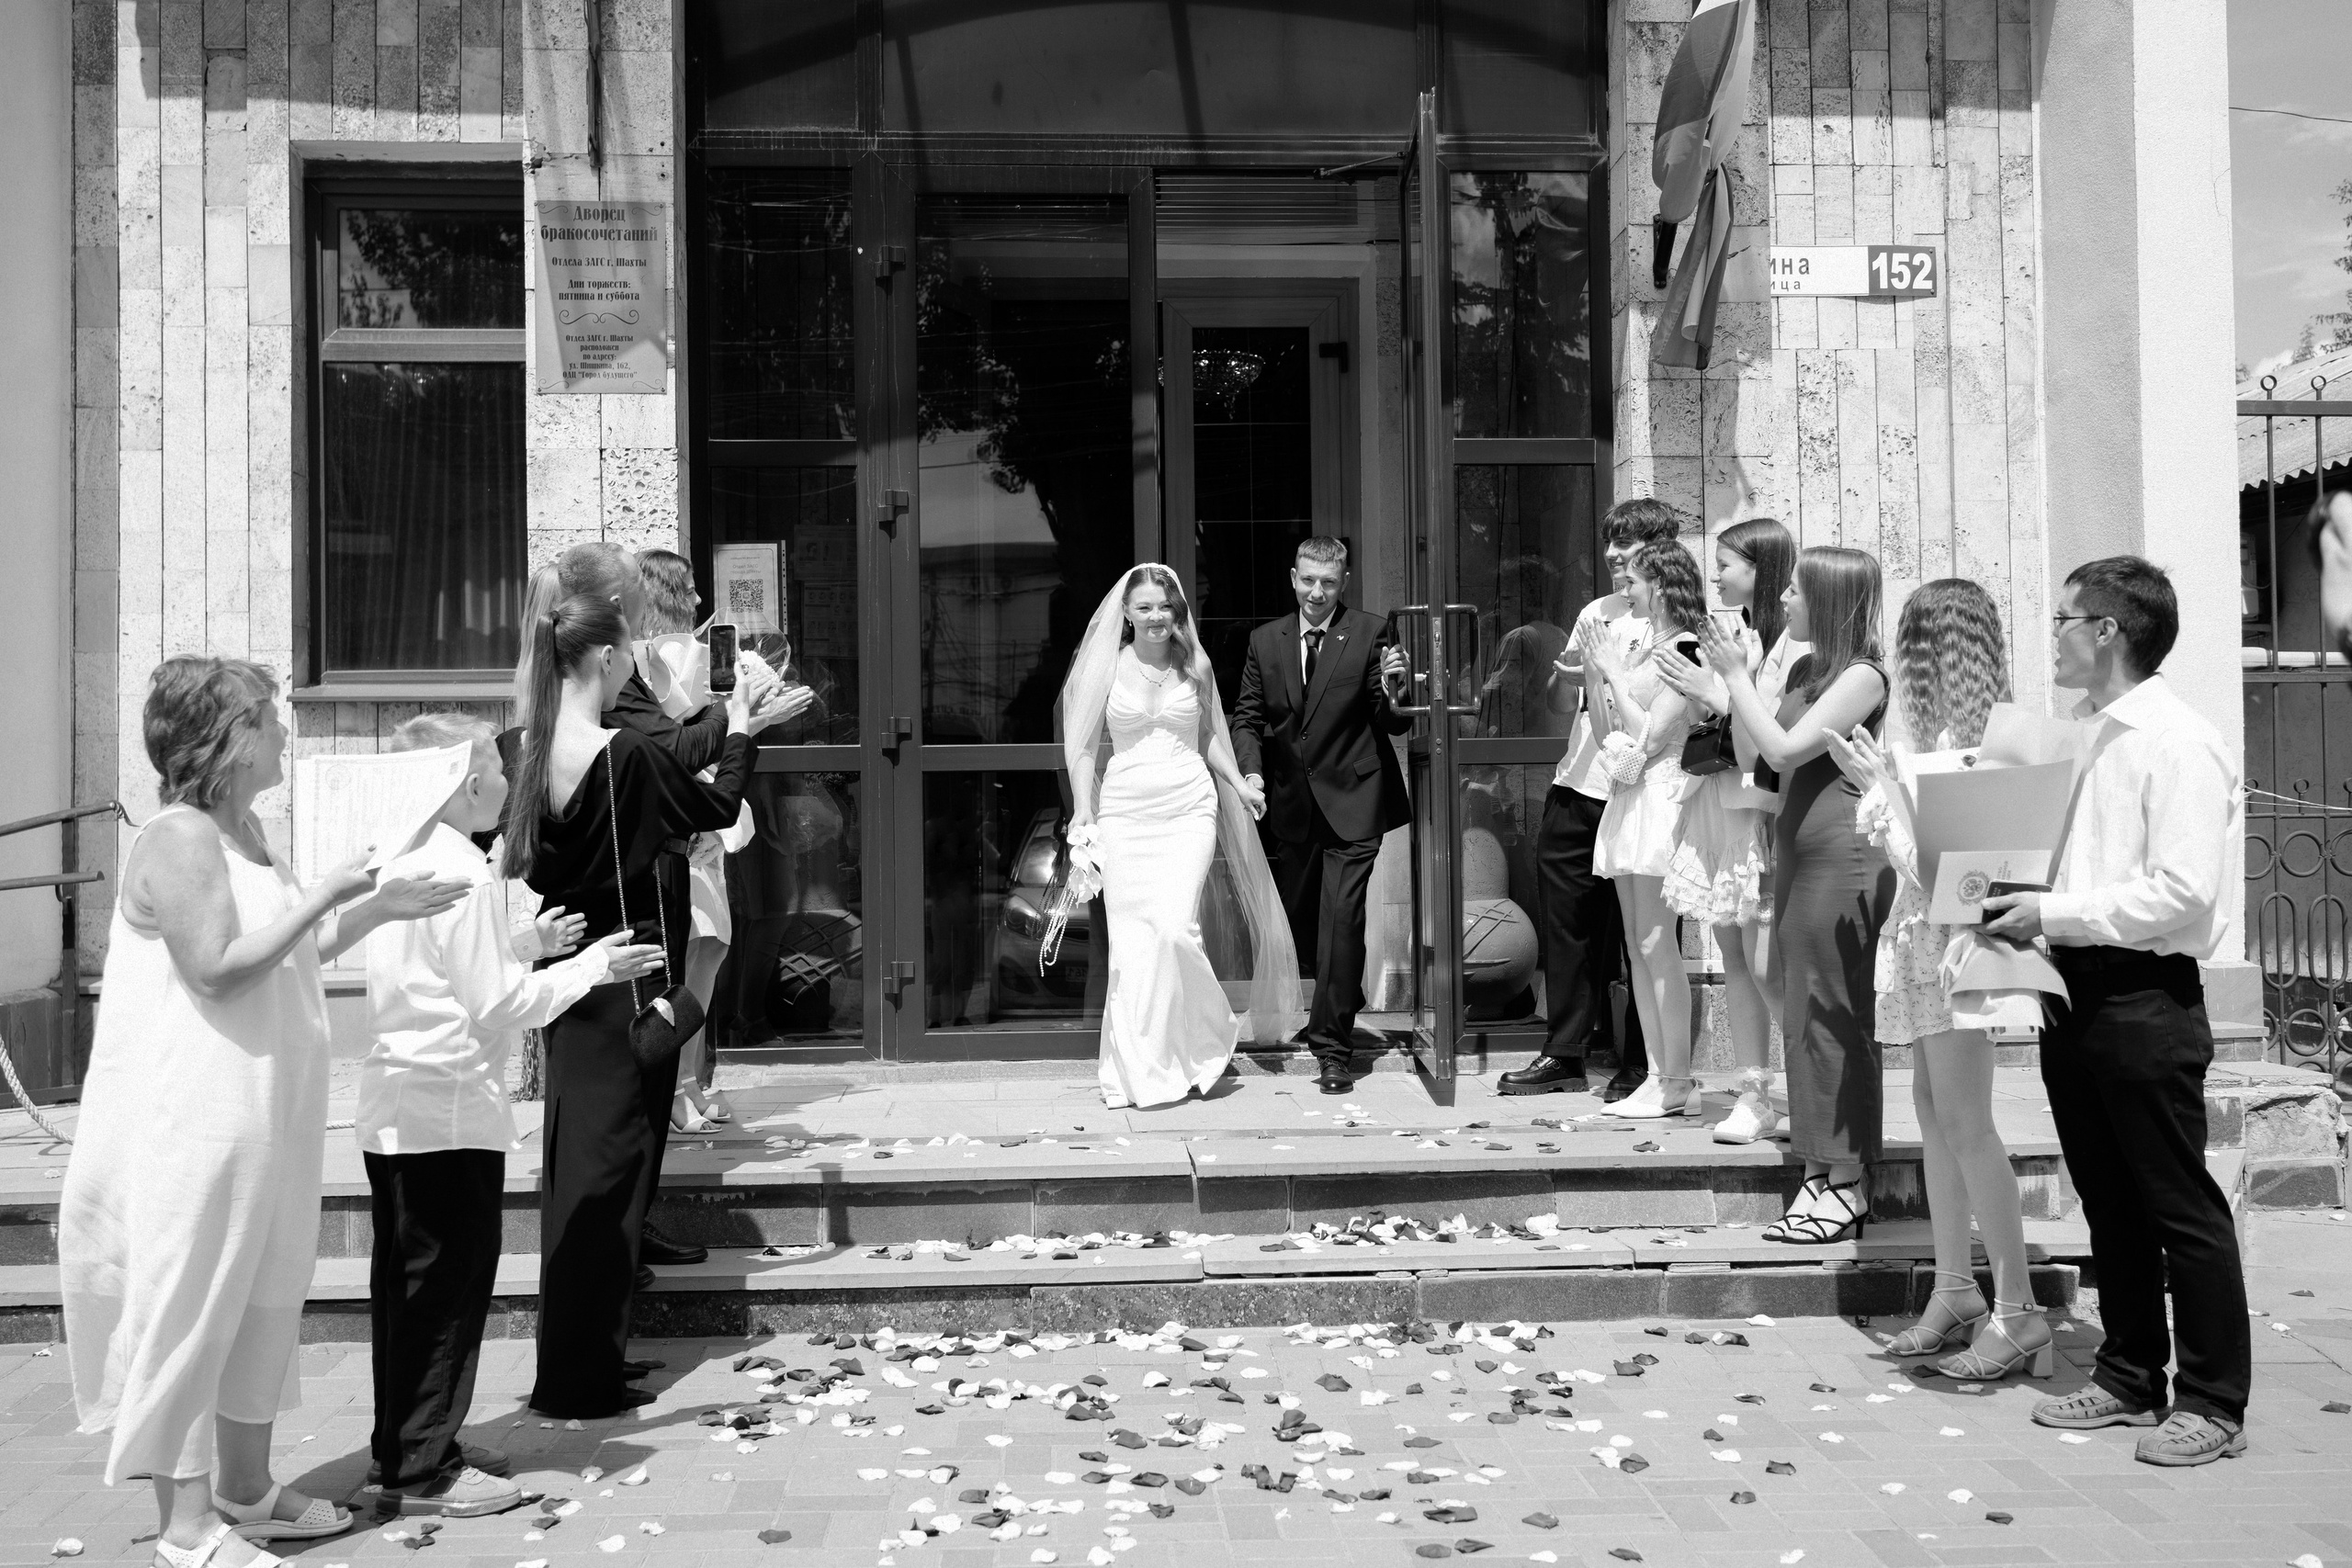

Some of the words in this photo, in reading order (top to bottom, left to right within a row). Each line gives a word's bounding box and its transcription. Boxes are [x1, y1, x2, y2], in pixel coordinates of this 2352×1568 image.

[573, 206, 626, 222] Дворец
[540, 225, 658, 242] бракосочетаний
[551, 256, 582, 267] Отдела
[584, 257, 605, 266] ЗАГС
[607, 258, 614, 267] г.
[616, 257, 647, 267] Шахты
[1871, 252, 1933, 290] 152
[568, 279, 584, 288] Дни
[587, 280, 631, 289] торжеств:
[559, 292, 595, 301] пятница
[597, 292, 604, 300] и
[605, 291, 639, 301] суббота
[565, 334, 585, 343] Отдел
[609, 334, 634, 343] Шахты
[616, 362, 631, 370] 162,
